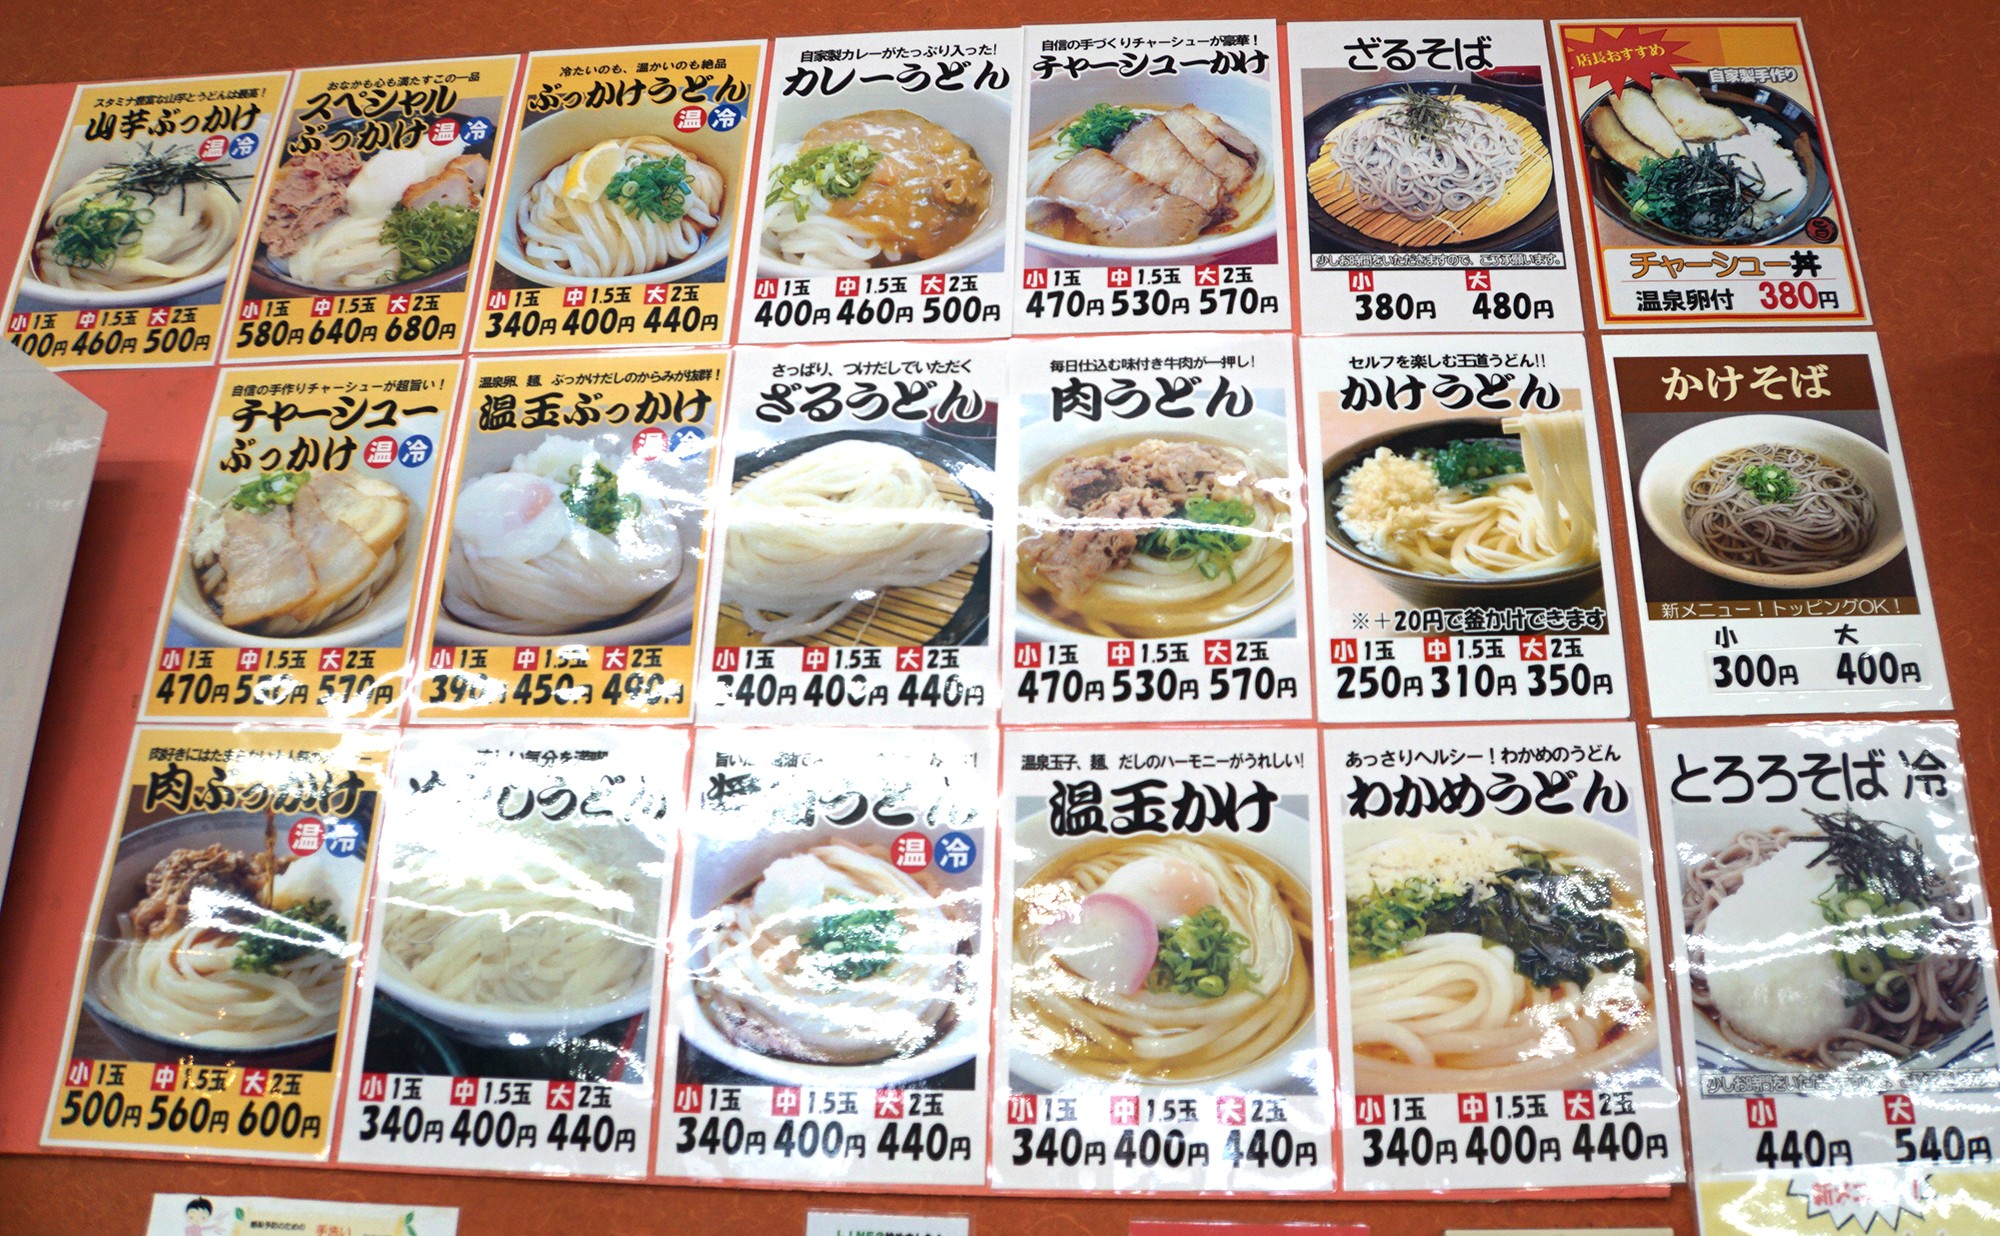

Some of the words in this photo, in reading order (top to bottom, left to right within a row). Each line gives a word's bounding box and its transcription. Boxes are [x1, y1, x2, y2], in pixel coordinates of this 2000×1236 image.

[560, 59, 726, 77] 冷たいのも、温かいのも絶品
[1033, 50, 1269, 79] チャーシューかけ
[1344, 36, 1493, 70] ざるそば
[1576, 44, 1665, 68] 店長おすすめ
[327, 72, 480, 91] おなかも心も満たすこの一品
[783, 61, 1010, 96] カレーうどん
[1709, 68, 1797, 84] 自家製手作り
[300, 85, 457, 121] スペシャル
[530, 75, 747, 111] ぶっかけうどん
[85, 103, 261, 140] 山芋ぶっかけ
[678, 109, 702, 130] 温
[711, 107, 737, 129] 冷
[200, 138, 226, 159] 温
[232, 136, 256, 156] 冷
[290, 119, 428, 154] ぶっかけ
[432, 123, 455, 142] 温
[464, 121, 488, 141] 冷
[1026, 270, 1045, 287] 小
[1054, 270, 1080, 286] 1玉
[1110, 268, 1129, 286] 中
[1139, 268, 1181, 285] 1.5玉
[1198, 267, 1217, 284] 大
[1223, 267, 1253, 283] 2玉
[1630, 250, 1822, 279] チャーシュー丼
[489, 292, 507, 309] 小
[515, 291, 540, 307] 1玉
[566, 288, 584, 305] 中
[592, 287, 631, 303] 1.5玉
[647, 287, 667, 303] 大
[670, 285, 699, 302] 2玉
[757, 280, 775, 298] 小
[784, 280, 810, 296] 1玉
[839, 278, 857, 296] 中
[866, 277, 907, 294] 1.5玉
[924, 275, 943, 293] 大
[949, 275, 978, 292] 2玉
[1352, 271, 1372, 291] 小
[1469, 271, 1489, 289] 大
[1636, 288, 1734, 311] 温泉卵付
[1759, 281, 1839, 310] 380円
[242, 303, 259, 318] 小
[266, 301, 290, 317] 1玉
[314, 299, 332, 316] 中
[338, 297, 377, 313] 1.5玉
[389, 296, 408, 312] 大
[412, 295, 440, 311] 2玉
[755, 299, 830, 327] 400円
[837, 298, 913, 325] 460円
[923, 296, 1000, 323] 500円
[1026, 290, 1104, 317] 470円
[1112, 289, 1189, 316] 530円
[1200, 287, 1278, 315] 570円
[1356, 293, 1436, 320] 380円
[1472, 292, 1554, 319] 480円
[237, 320, 304, 348] 580円
[309, 318, 377, 345] 640円
[385, 315, 456, 342] 680円
[486, 311, 557, 338] 340円
[562, 308, 635, 335] 400円
[643, 306, 718, 333] 440円
[71, 330, 137, 356] 460円
[143, 327, 210, 353] 500円
[1341, 373, 1560, 411] かけうどん
[1662, 364, 1831, 401] かけそば
[232, 396, 438, 432] チャーシュー
[479, 389, 711, 431] 温玉ぶっかけ
[756, 380, 986, 422] ざるうどん
[1052, 376, 1254, 422] 肉うどん
[220, 436, 357, 472] ぶっかけ
[366, 440, 393, 464] 温
[401, 439, 430, 463] 冷
[1333, 640, 1355, 662] 小
[1365, 640, 1395, 660] 1玉
[1427, 639, 1448, 660] 中
[1458, 639, 1505, 658] 1.5玉
[1522, 638, 1544, 659] 大
[1551, 638, 1584, 658] 2玉
[1715, 626, 1738, 648] 小
[1834, 624, 1859, 644] 大
[1016, 645, 1038, 667] 小
[1050, 645, 1078, 664] 1玉
[1111, 643, 1132, 665] 中
[1142, 643, 1189, 663] 1.5玉
[1207, 642, 1229, 663] 大
[1237, 642, 1269, 661] 2玉
[1713, 654, 1799, 688] 300円
[1837, 652, 1922, 684] 400円
[156, 673, 229, 704] 470円
[513, 673, 592, 705] 450円
[804, 674, 888, 707] 400円
[898, 674, 984, 707] 440円
[1018, 670, 1105, 703] 470円
[1113, 669, 1199, 702] 530円
[1211, 667, 1297, 700] 570円
[1336, 665, 1423, 699] 250円
[1431, 664, 1517, 697] 310円
[1528, 663, 1613, 696] 350円
[1671, 749, 1889, 803] とろろそば
[1898, 750, 1948, 800] 冷
[1050, 779, 1278, 836] 温玉かけ
[1348, 770, 1628, 818] わかめうどん
[292, 823, 323, 850] 温
[896, 837, 927, 868] 温
[939, 837, 971, 868] 冷
[362, 1078, 383, 1100] 小
[393, 1078, 422, 1100] 1玉
[454, 1082, 476, 1104] 中
[485, 1082, 532, 1105] 1.5玉
[549, 1086, 572, 1108] 大
[578, 1086, 612, 1108] 2玉
[61, 1091, 142, 1128] 500円
[147, 1096, 229, 1133] 560円
[238, 1101, 320, 1138] 600円
[1750, 1100, 1775, 1126] 小
[1888, 1096, 1912, 1123] 大
[360, 1106, 443, 1142] 340円
[451, 1110, 537, 1148] 400円
[547, 1114, 636, 1152] 440円
[677, 1117, 766, 1155] 340円
[774, 1120, 865, 1158] 400円
[877, 1122, 971, 1161] 440円
[1363, 1127, 1457, 1166] 340円
[1466, 1125, 1561, 1165] 400円
[1572, 1122, 1668, 1162] 440円
[1013, 1128, 1106, 1166] 340円
[1114, 1129, 1209, 1167] 400円
[1223, 1129, 1317, 1168] 440円
[1756, 1130, 1852, 1169] 440円
[1896, 1126, 1992, 1163] 540円
